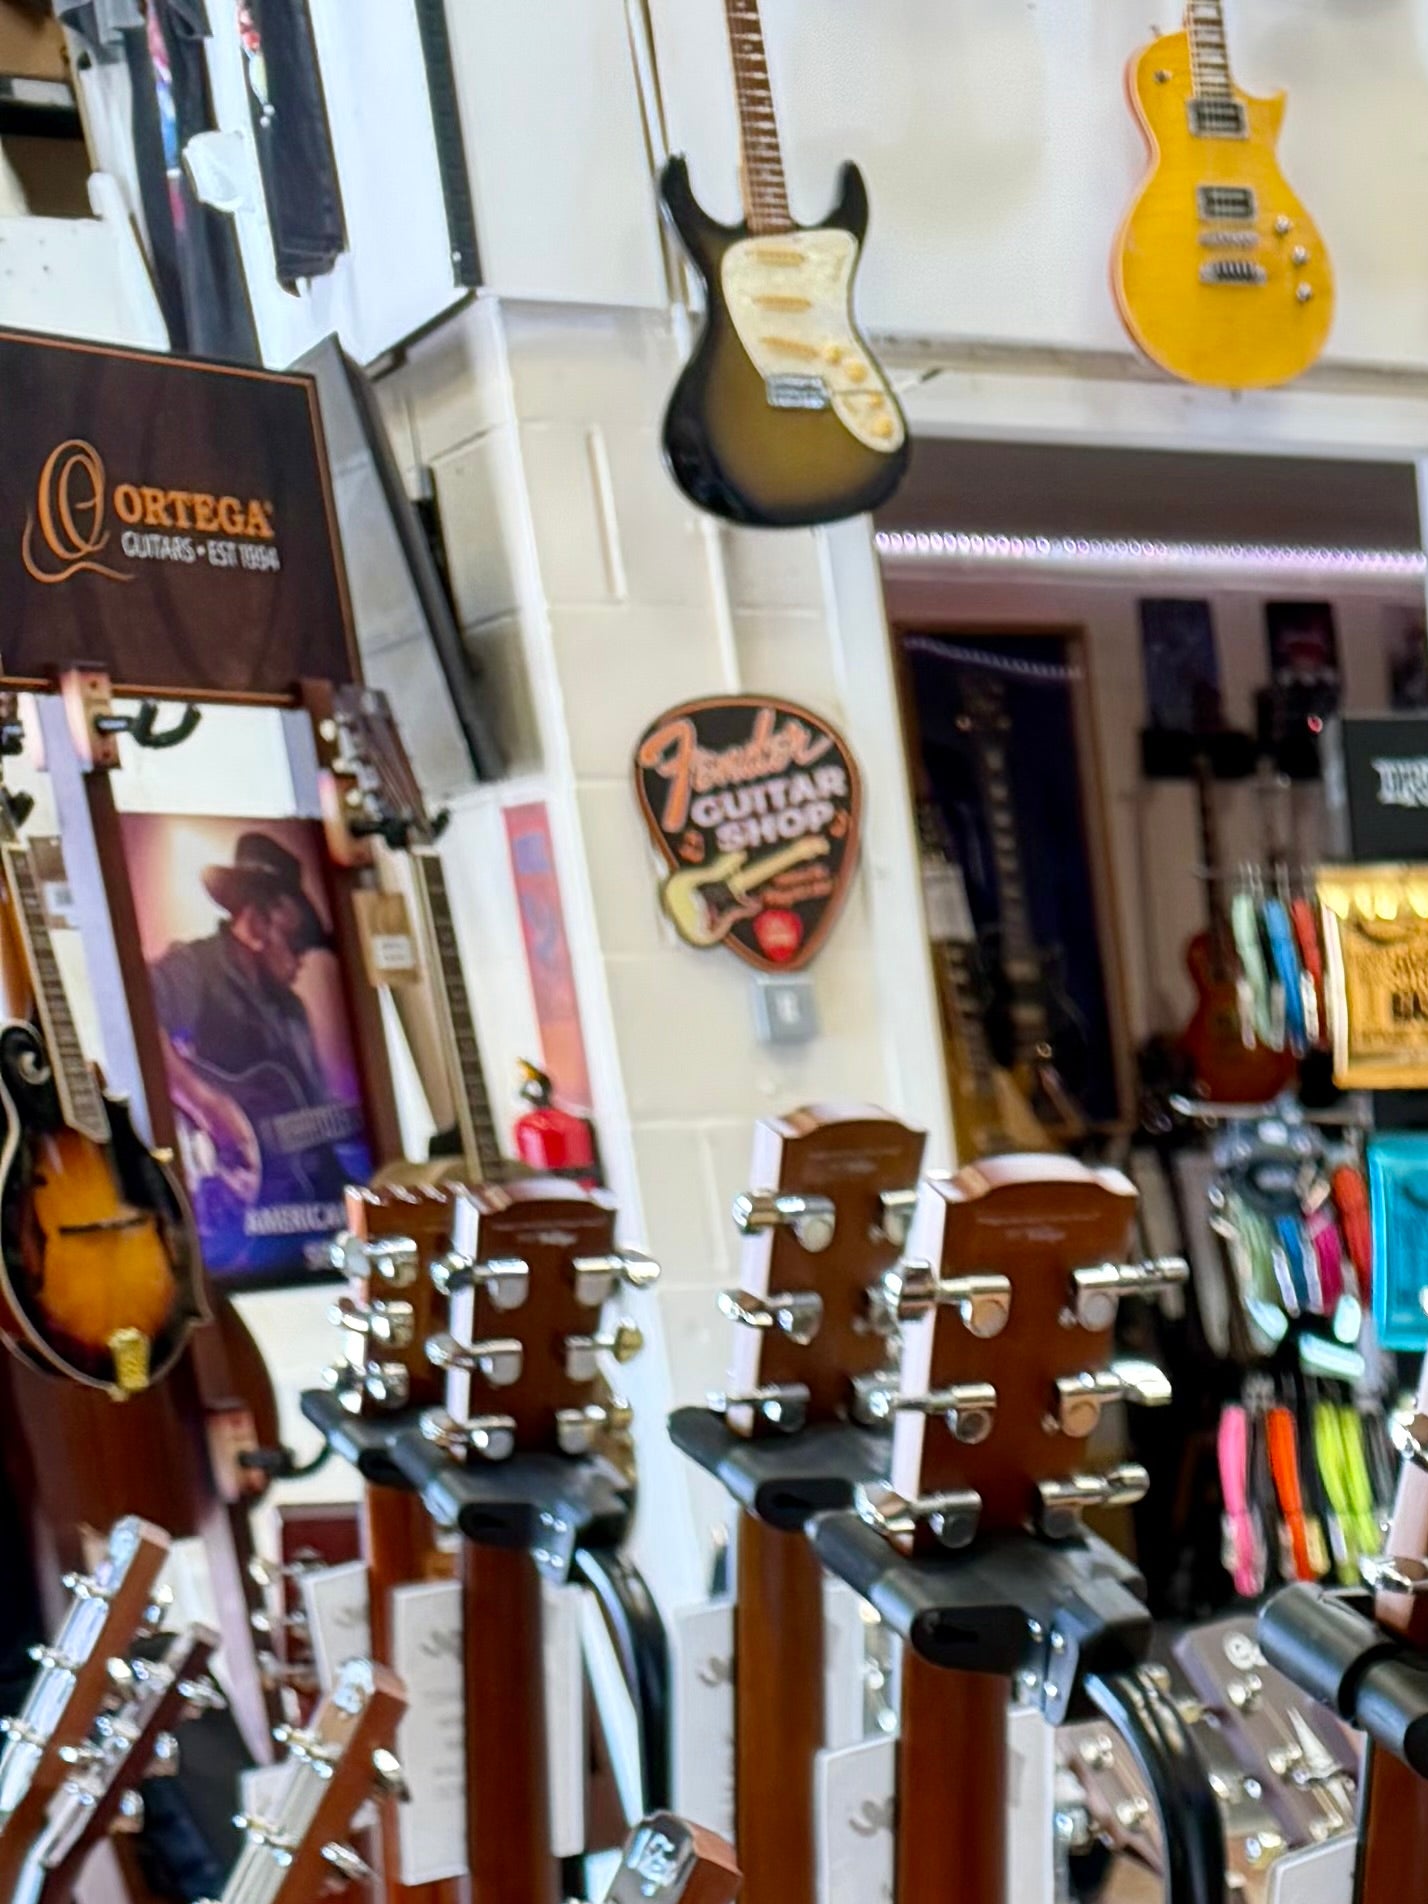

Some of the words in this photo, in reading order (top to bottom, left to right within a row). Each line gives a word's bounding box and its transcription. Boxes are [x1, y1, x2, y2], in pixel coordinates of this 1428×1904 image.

[113, 484, 274, 537] ORTEGA
[121, 531, 196, 565] GUITARS
[639, 708, 836, 833] Fender
[690, 765, 848, 828] GUITAR
[714, 802, 836, 852] SHOP
